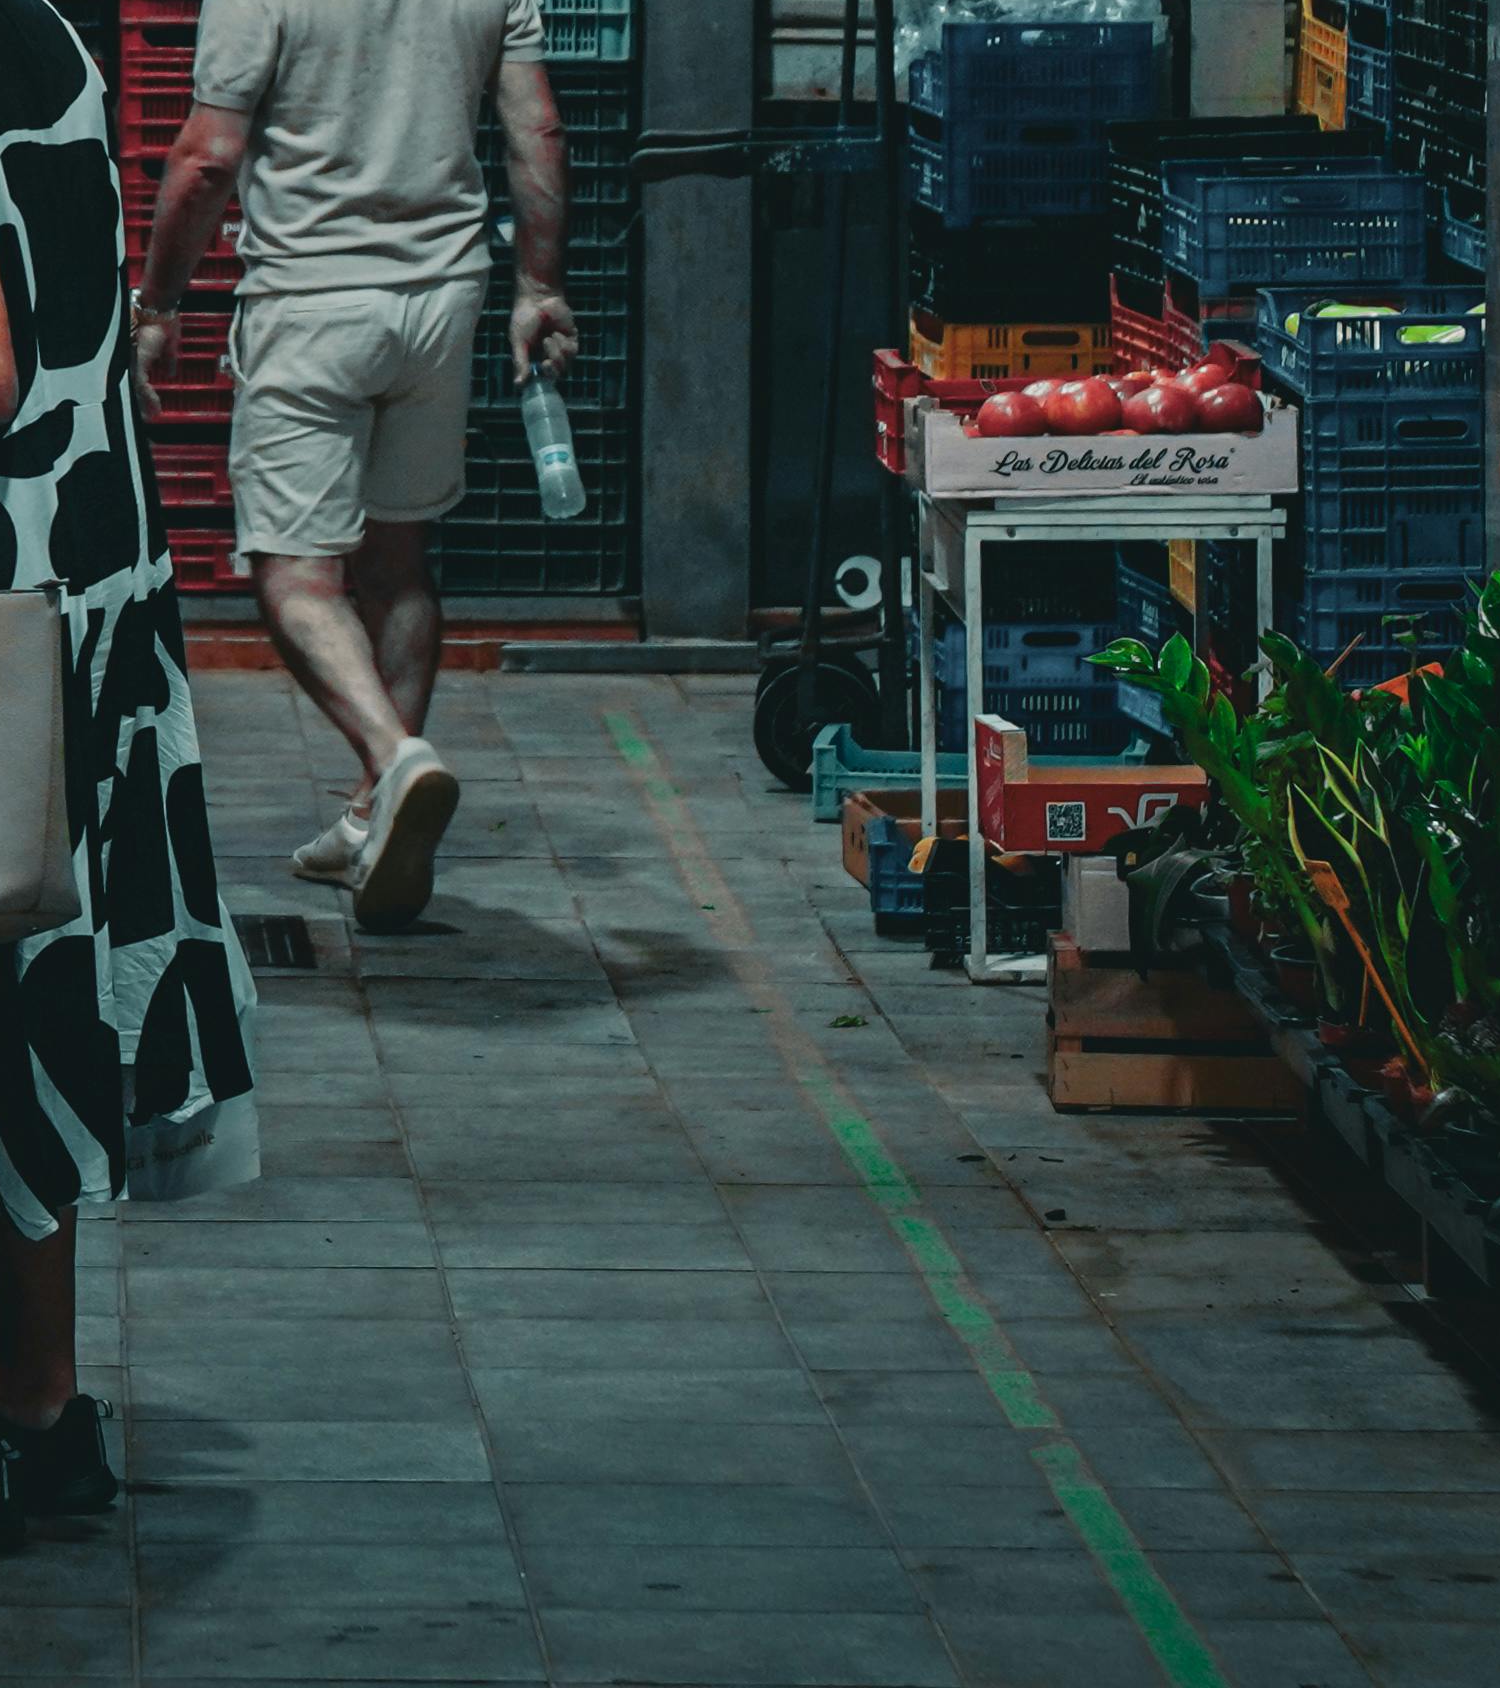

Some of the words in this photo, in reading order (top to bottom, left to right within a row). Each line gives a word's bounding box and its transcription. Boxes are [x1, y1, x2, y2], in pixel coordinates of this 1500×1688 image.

[988, 450, 1032, 476] Las
[1040, 449, 1126, 474] Delicias
[1129, 447, 1168, 470] del
